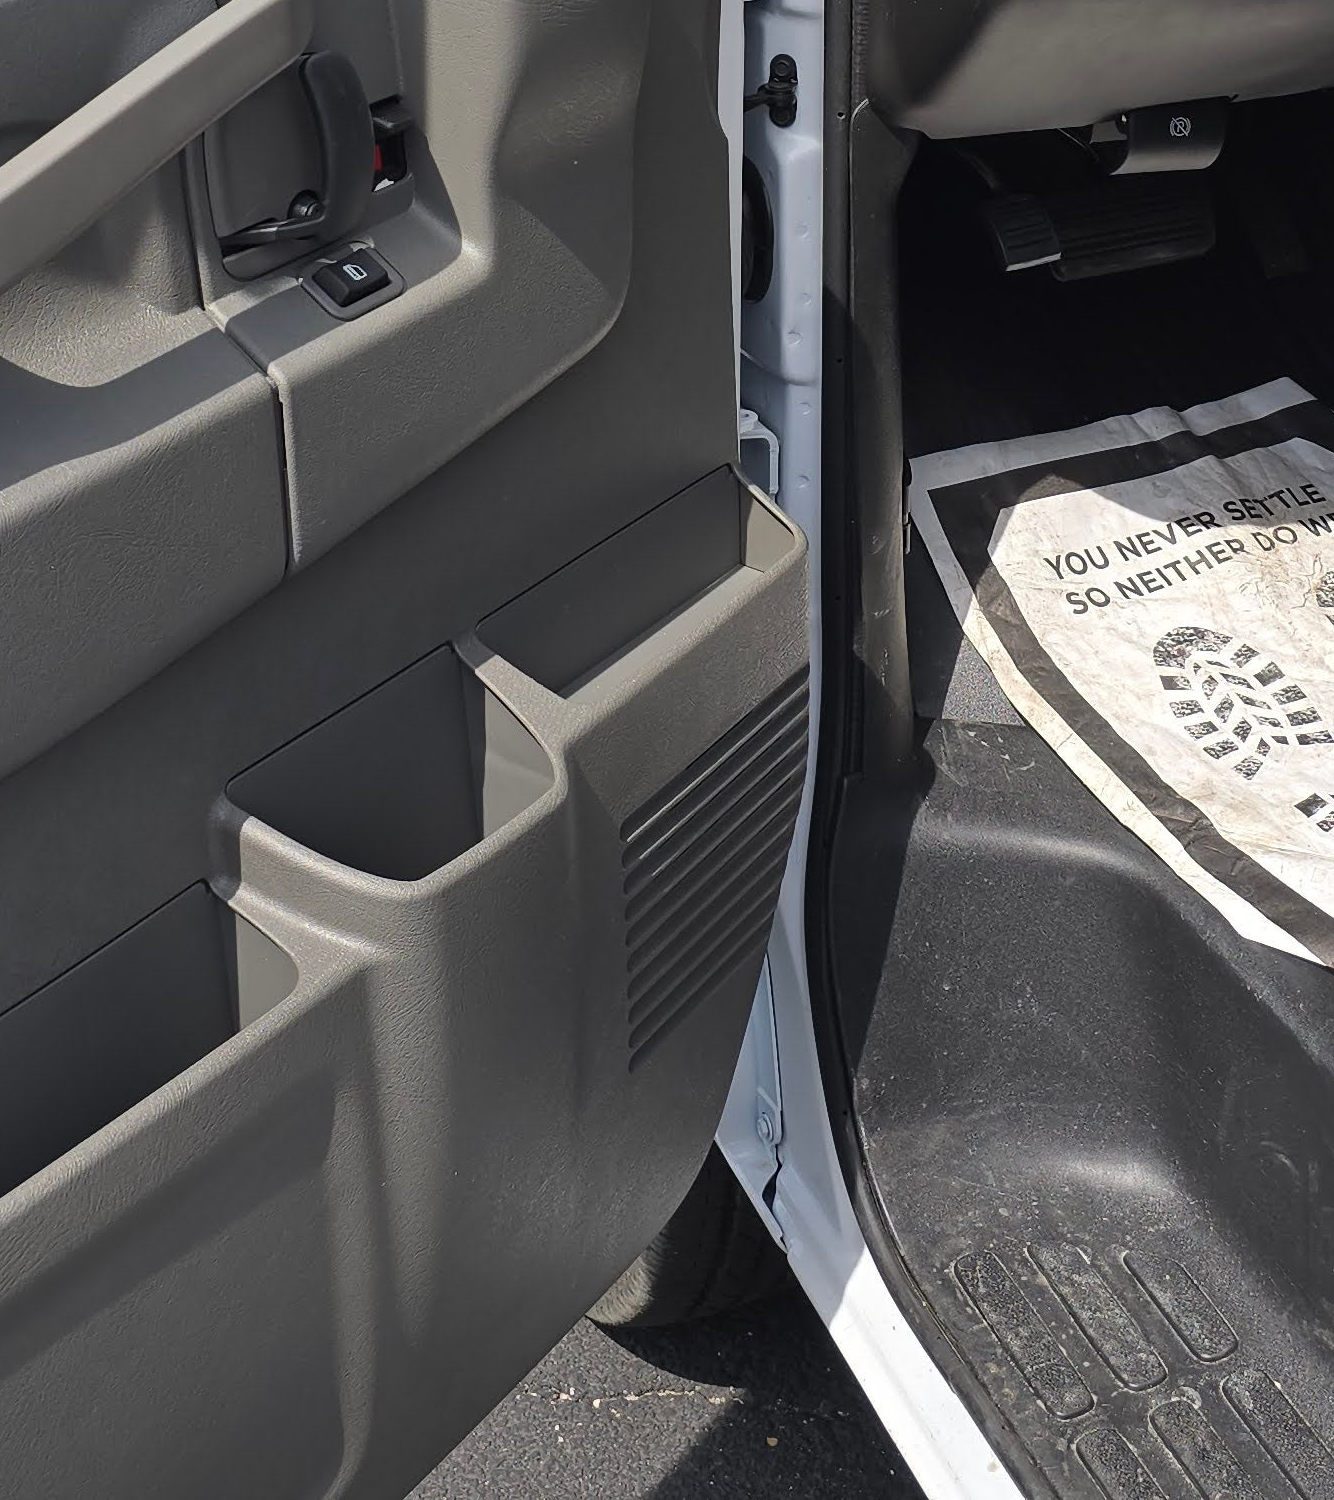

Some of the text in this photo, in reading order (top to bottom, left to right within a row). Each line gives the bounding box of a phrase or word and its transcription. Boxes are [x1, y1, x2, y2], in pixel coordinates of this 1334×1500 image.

[1044, 483, 1326, 580] YOU NEVER SETTLE
[1066, 587, 1111, 615] SO
[1113, 537, 1246, 599] NEITHER
[1252, 526, 1298, 551] DO
